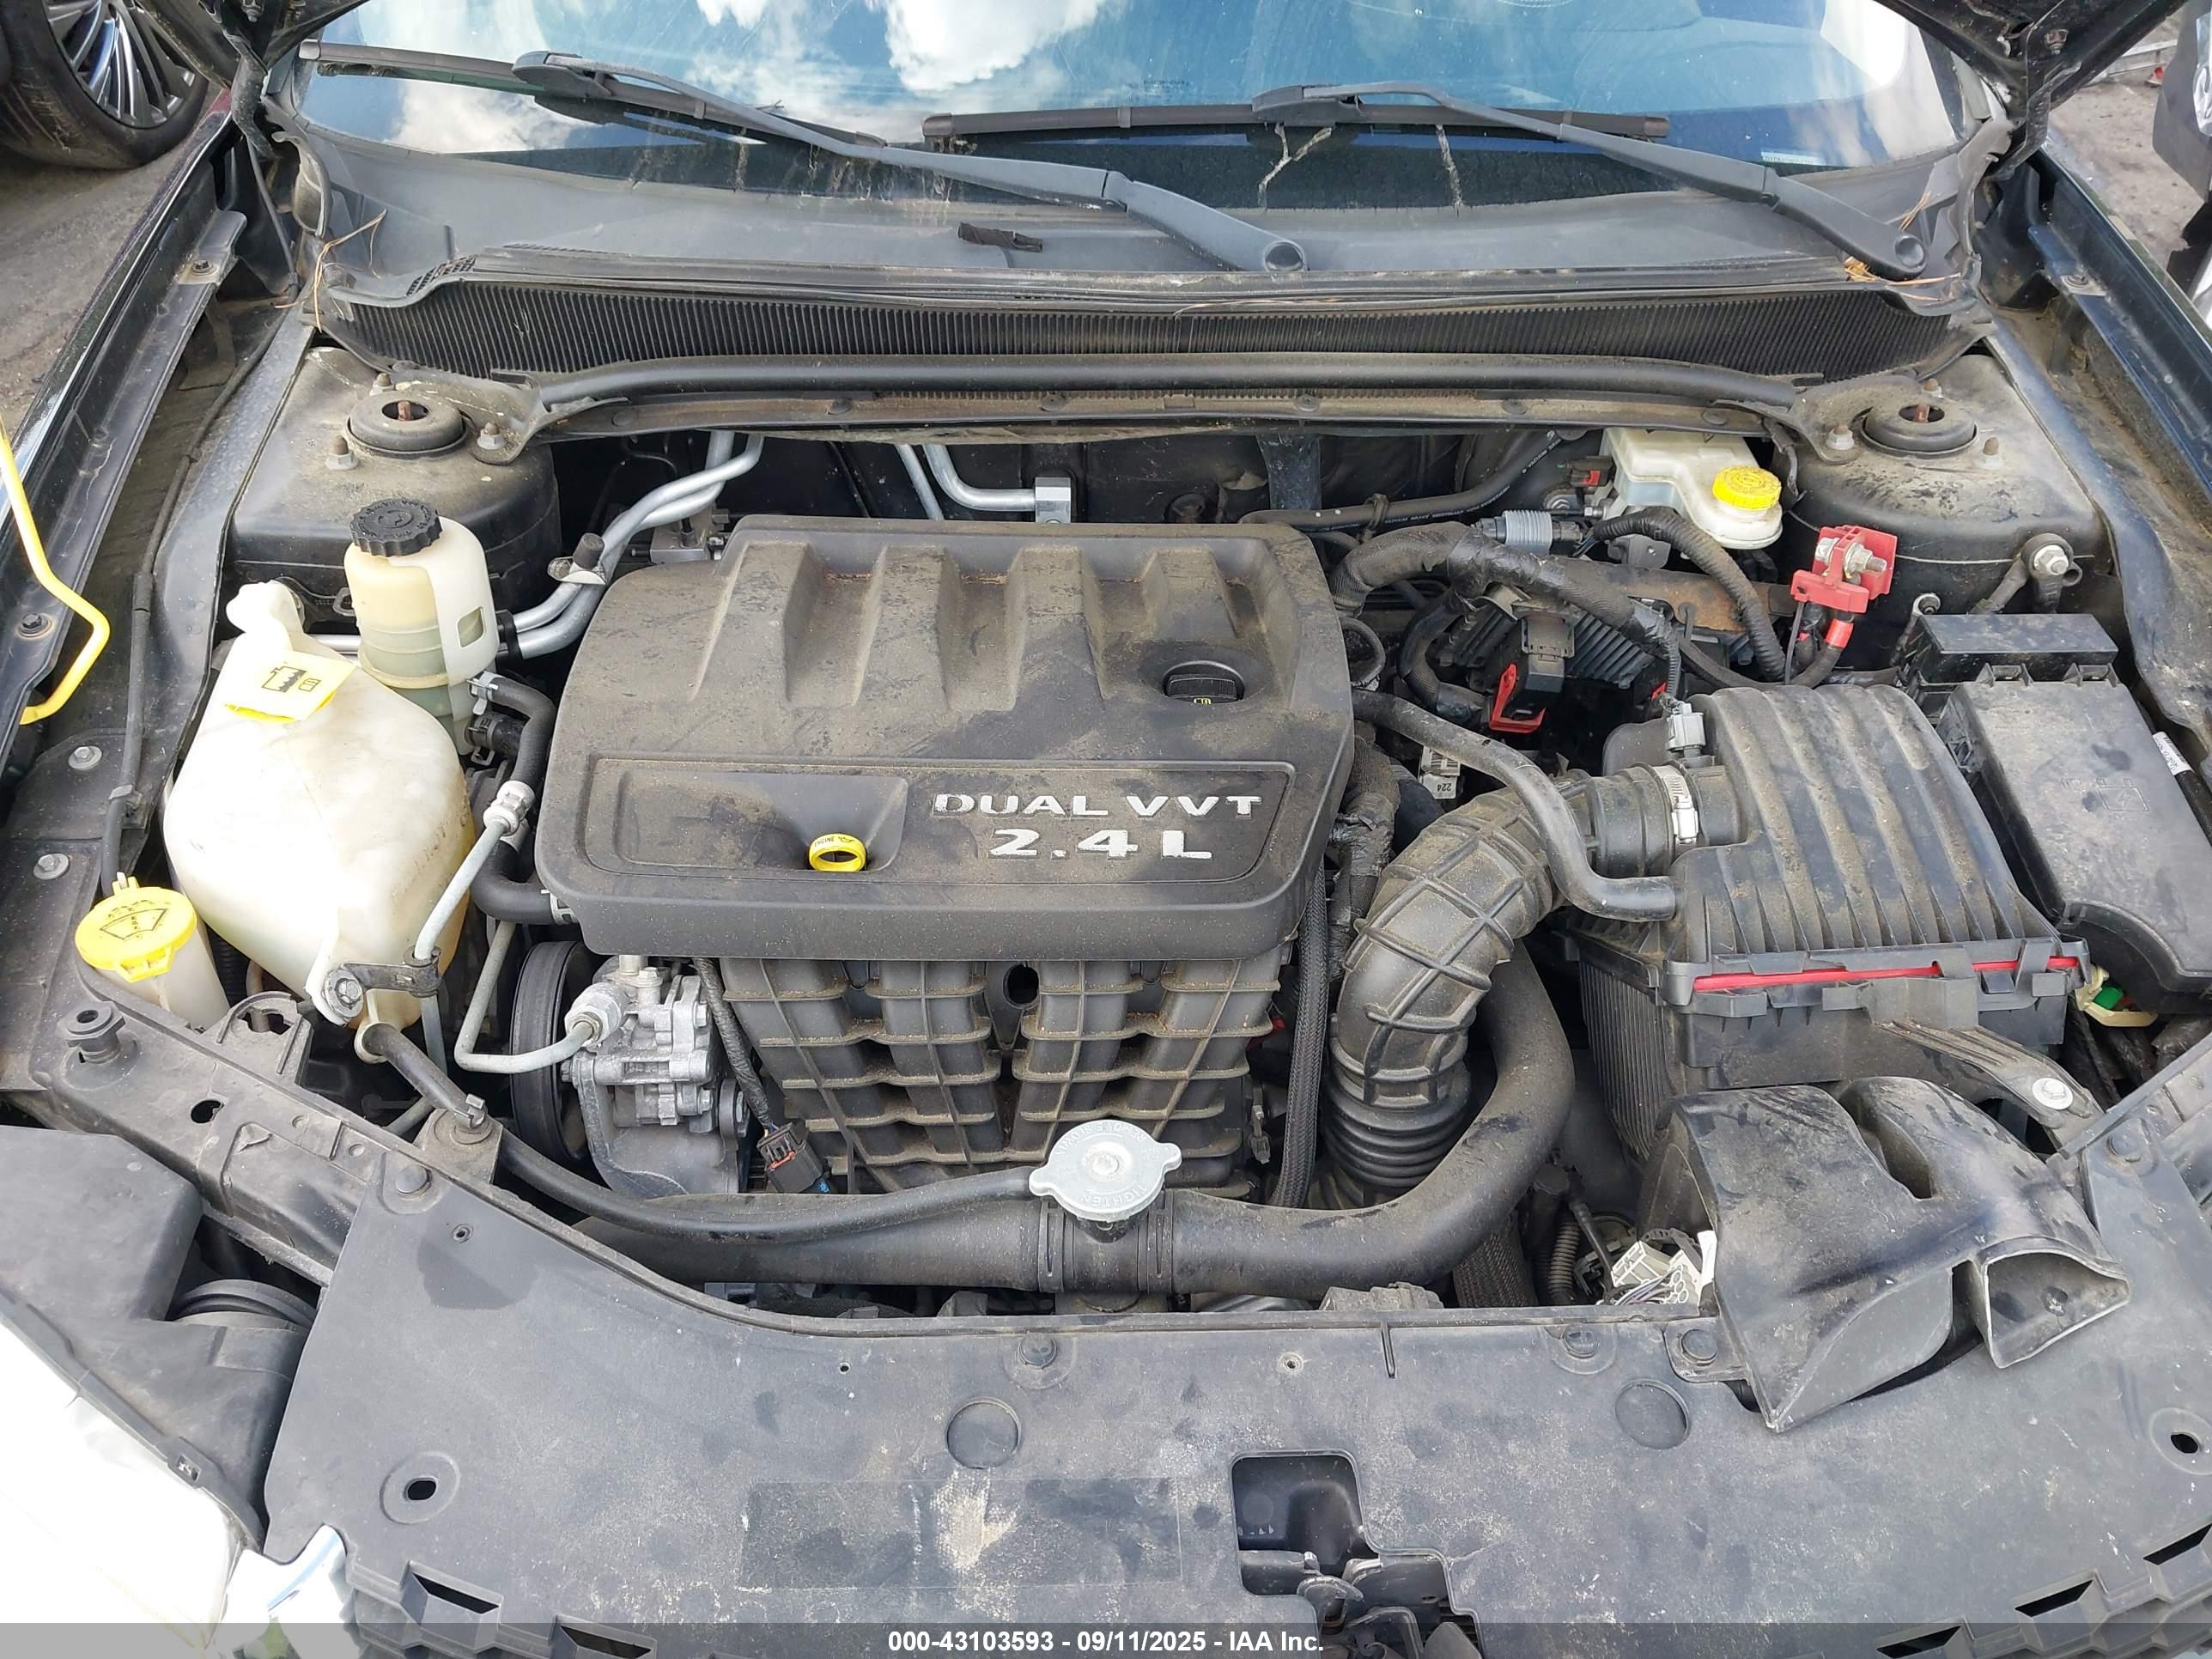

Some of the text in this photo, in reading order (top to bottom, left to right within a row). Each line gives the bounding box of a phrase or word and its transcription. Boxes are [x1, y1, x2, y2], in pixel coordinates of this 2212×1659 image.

[933, 793, 1262, 817] DUAL VVT
[814, 836, 835, 848] ENGINE
